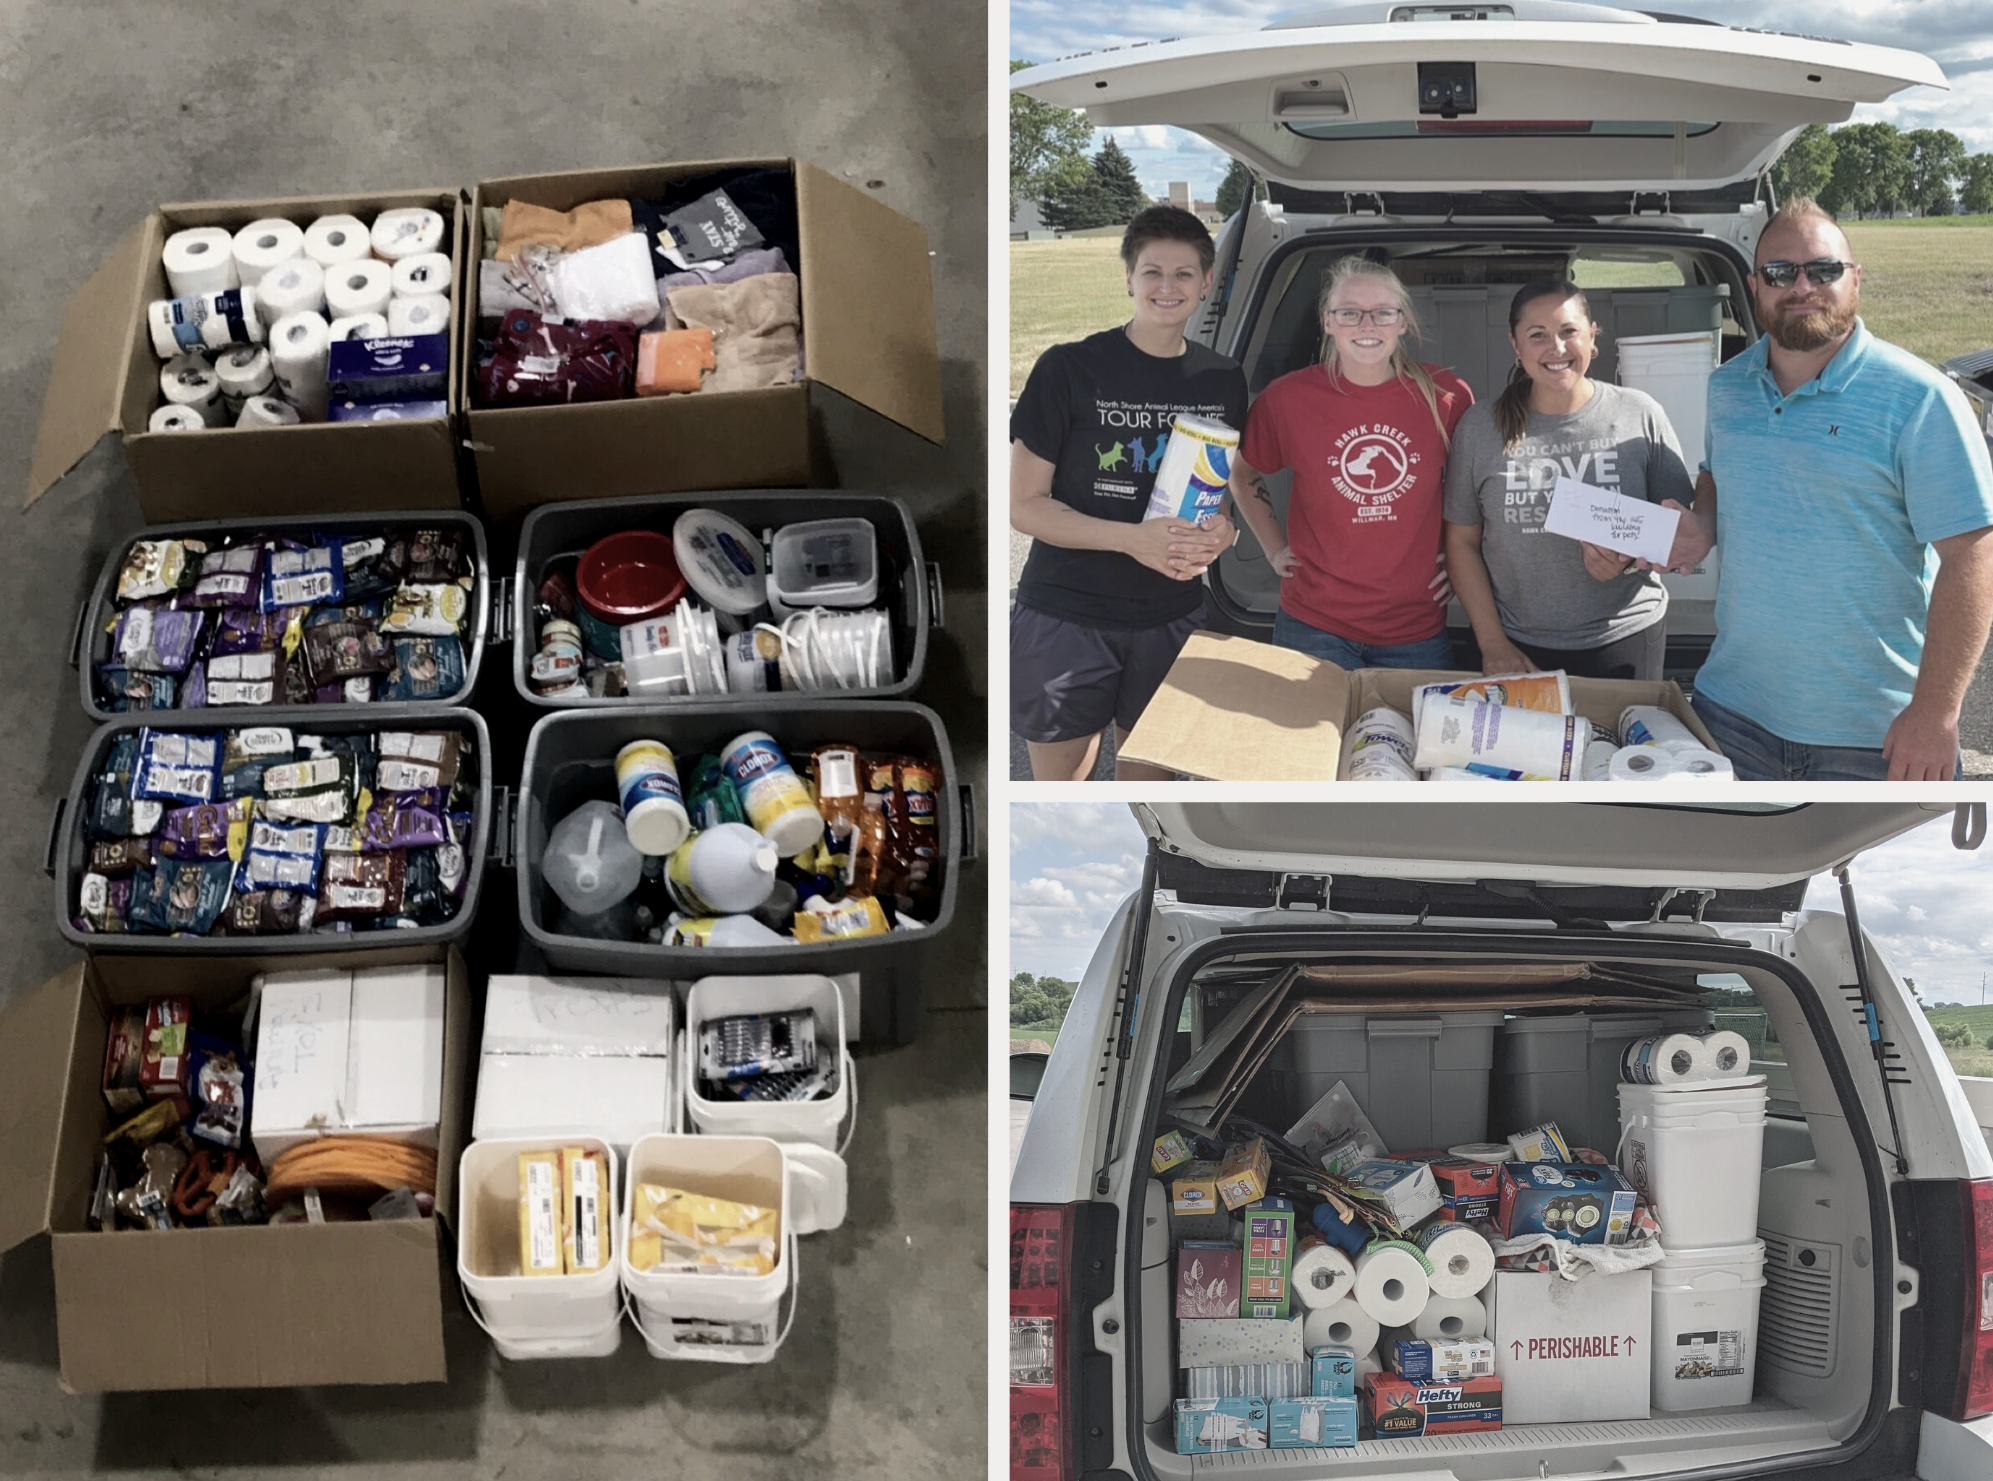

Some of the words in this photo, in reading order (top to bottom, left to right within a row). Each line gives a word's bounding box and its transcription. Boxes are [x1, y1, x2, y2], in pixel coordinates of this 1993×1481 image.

[1096, 400, 1119, 409] North
[1120, 401, 1142, 410] Shore
[1145, 402, 1168, 411] Animal
[1169, 404, 1196, 412] League
[1197, 404, 1225, 412] America's
[1097, 408, 1152, 428] TOUR
[1334, 424, 1369, 449] HAWK
[1373, 423, 1412, 447] CREEK
[1541, 441, 1585, 456] CAN'T
[1589, 438, 1619, 450] BUY
[1506, 451, 1620, 491] LOVE
[1331, 476, 1367, 505] ANIMAL
[1372, 474, 1417, 506] SHELTER
[1504, 492, 1538, 506] BUT
[738, 750, 774, 777] CLOROX
[1182, 1191, 1203, 1199] CLOROX
[1238, 1180, 1252, 1196] GLAD
[1466, 1208, 1488, 1217] Hefty
[1528, 1335, 1619, 1360] PERISHABLE
[1418, 1388, 1460, 1403] Hefty
[1447, 1401, 1482, 1410] STRONG
[1384, 1419, 1393, 1428] #1
[1394, 1418, 1417, 1427] VALUE
